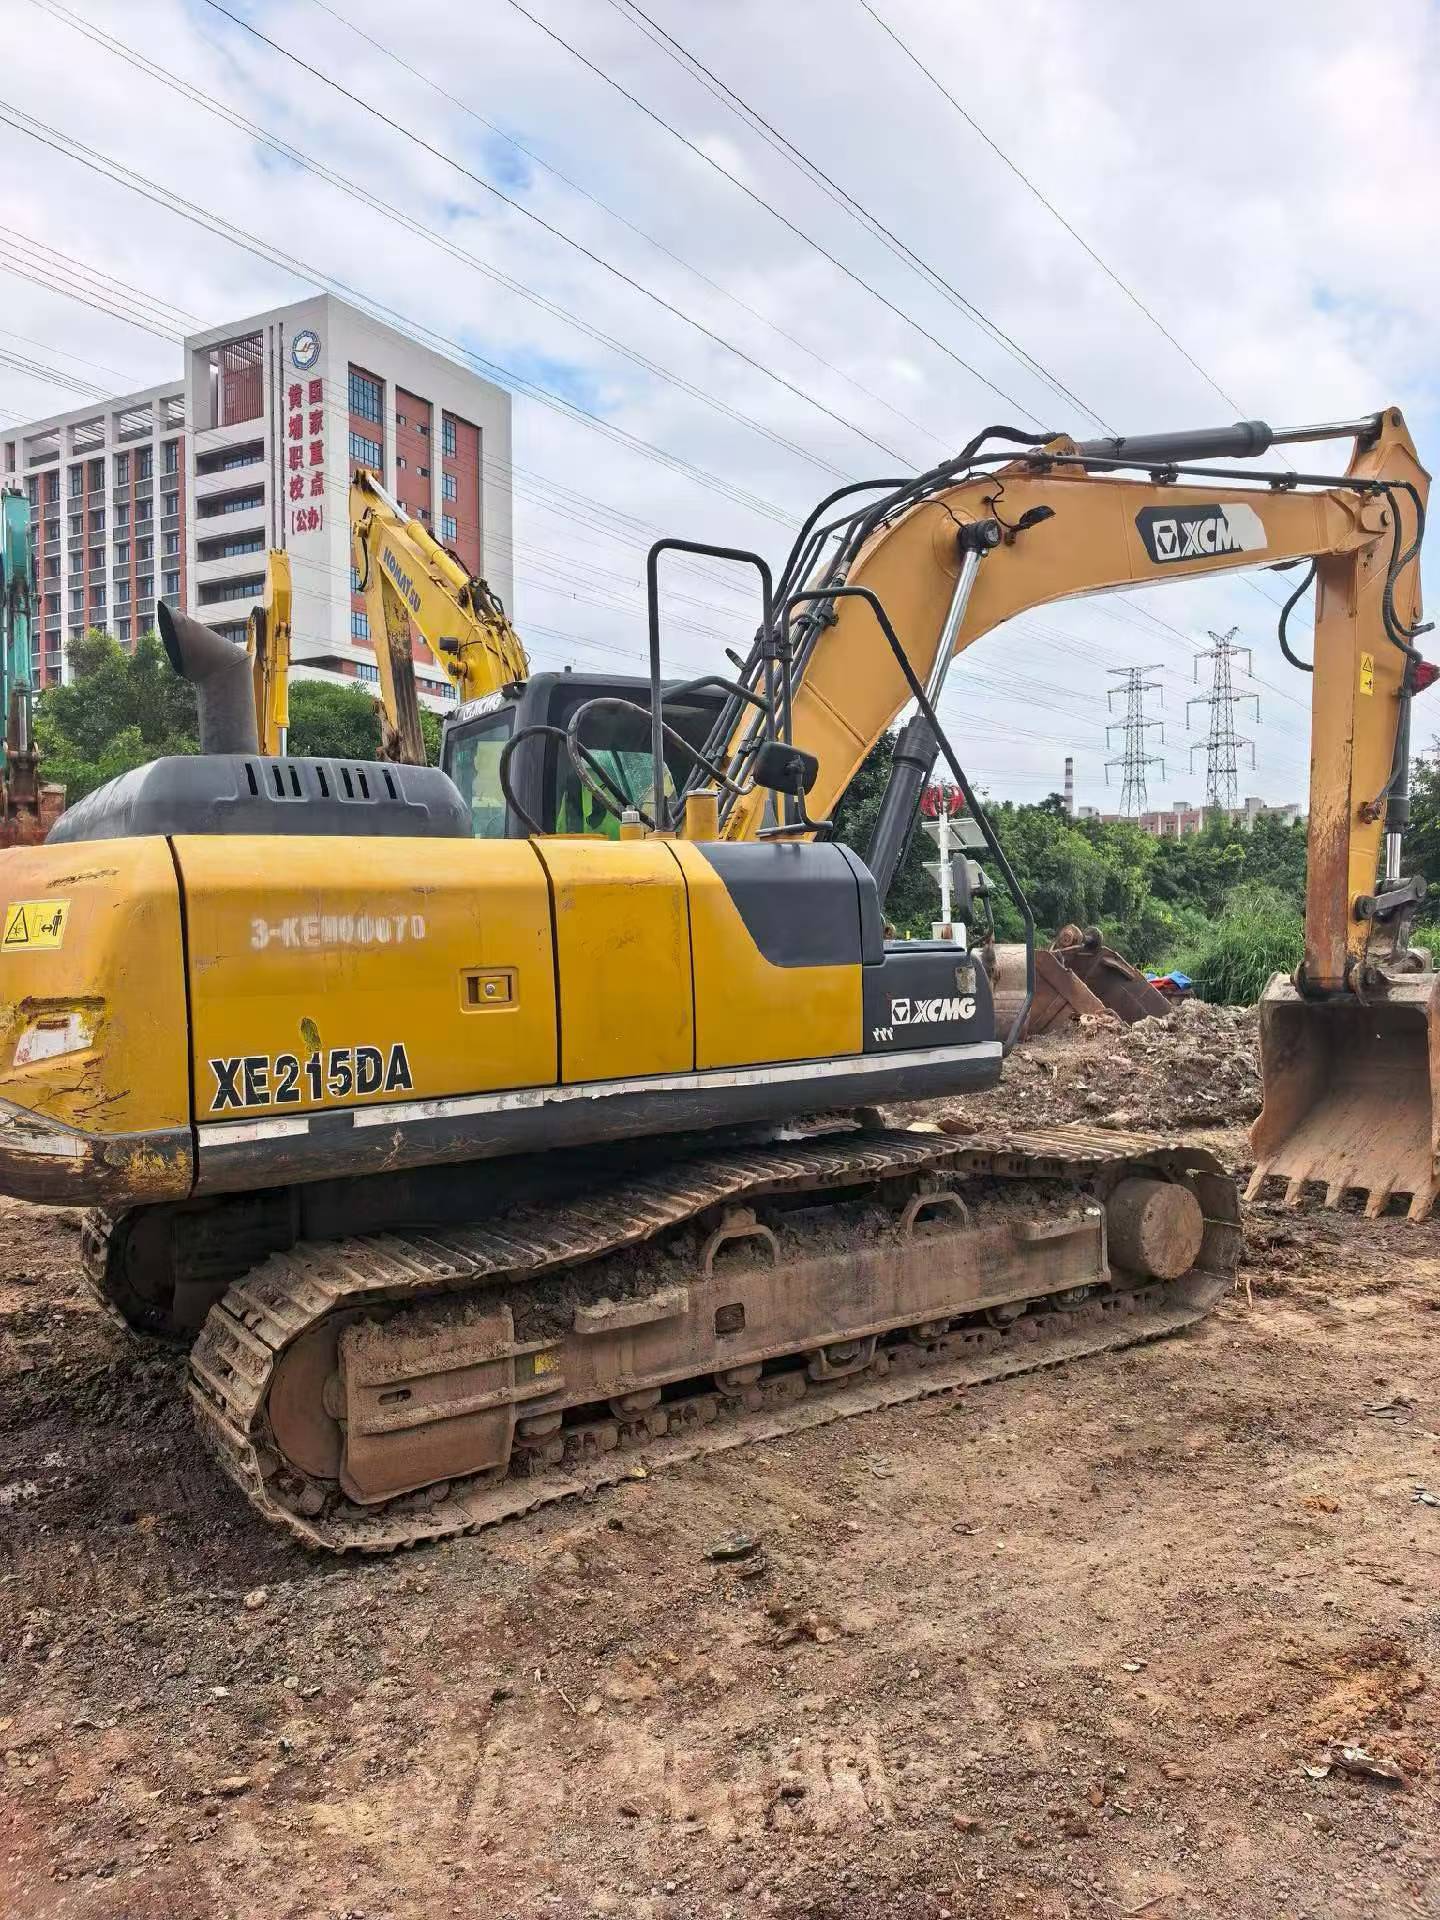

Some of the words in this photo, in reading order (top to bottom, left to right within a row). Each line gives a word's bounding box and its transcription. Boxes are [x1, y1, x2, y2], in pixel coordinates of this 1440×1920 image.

[288, 383, 304, 501] 黄埔职校
[308, 378, 324, 497] 国家重点
[910, 997, 977, 1024] XCMG
[208, 1042, 415, 1112] XE215DA
